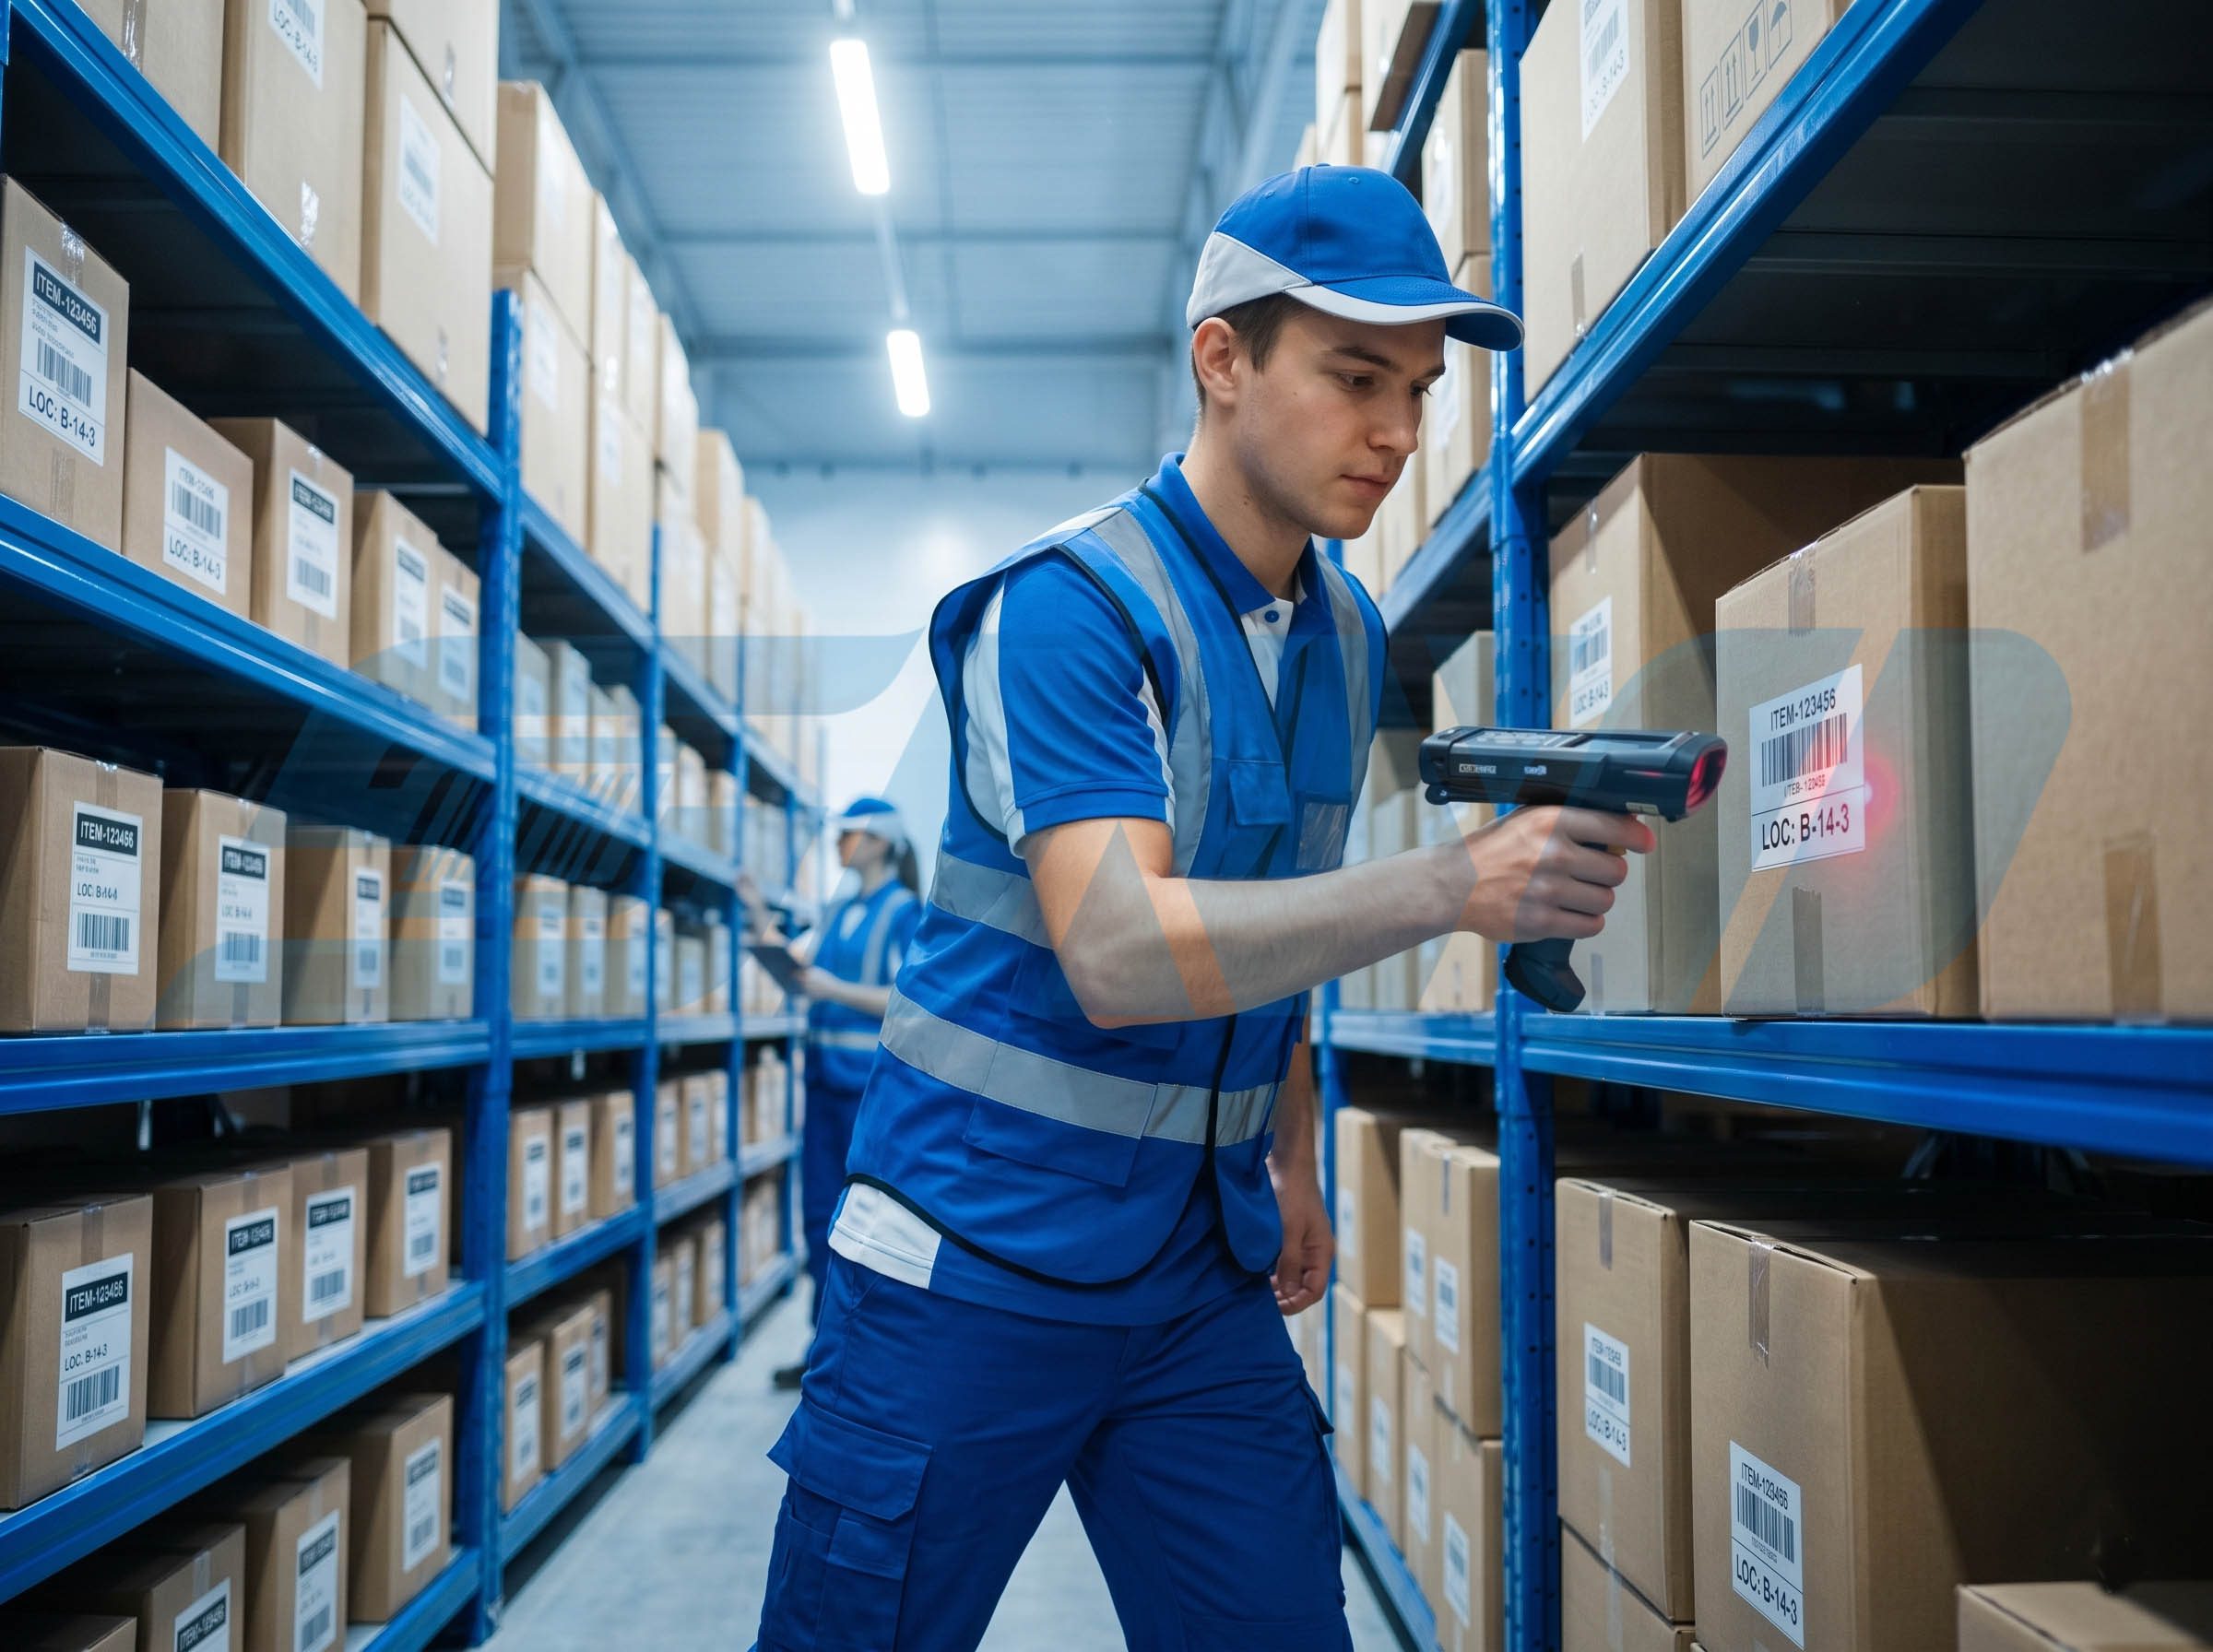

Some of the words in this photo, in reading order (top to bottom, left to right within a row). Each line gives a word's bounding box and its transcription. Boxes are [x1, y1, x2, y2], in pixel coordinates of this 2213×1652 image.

[36, 271, 97, 335] ITEM-123456
[29, 385, 56, 422] LOC:
[61, 406, 95, 448] B-14-3
[1770, 688, 1836, 731] ITEM-123456
[1762, 818, 1795, 850] LOC:
[1800, 803, 1850, 842] B-14-3
[1735, 1554, 1761, 1595] LOC:
[1763, 1575, 1797, 1625] B-14-3
